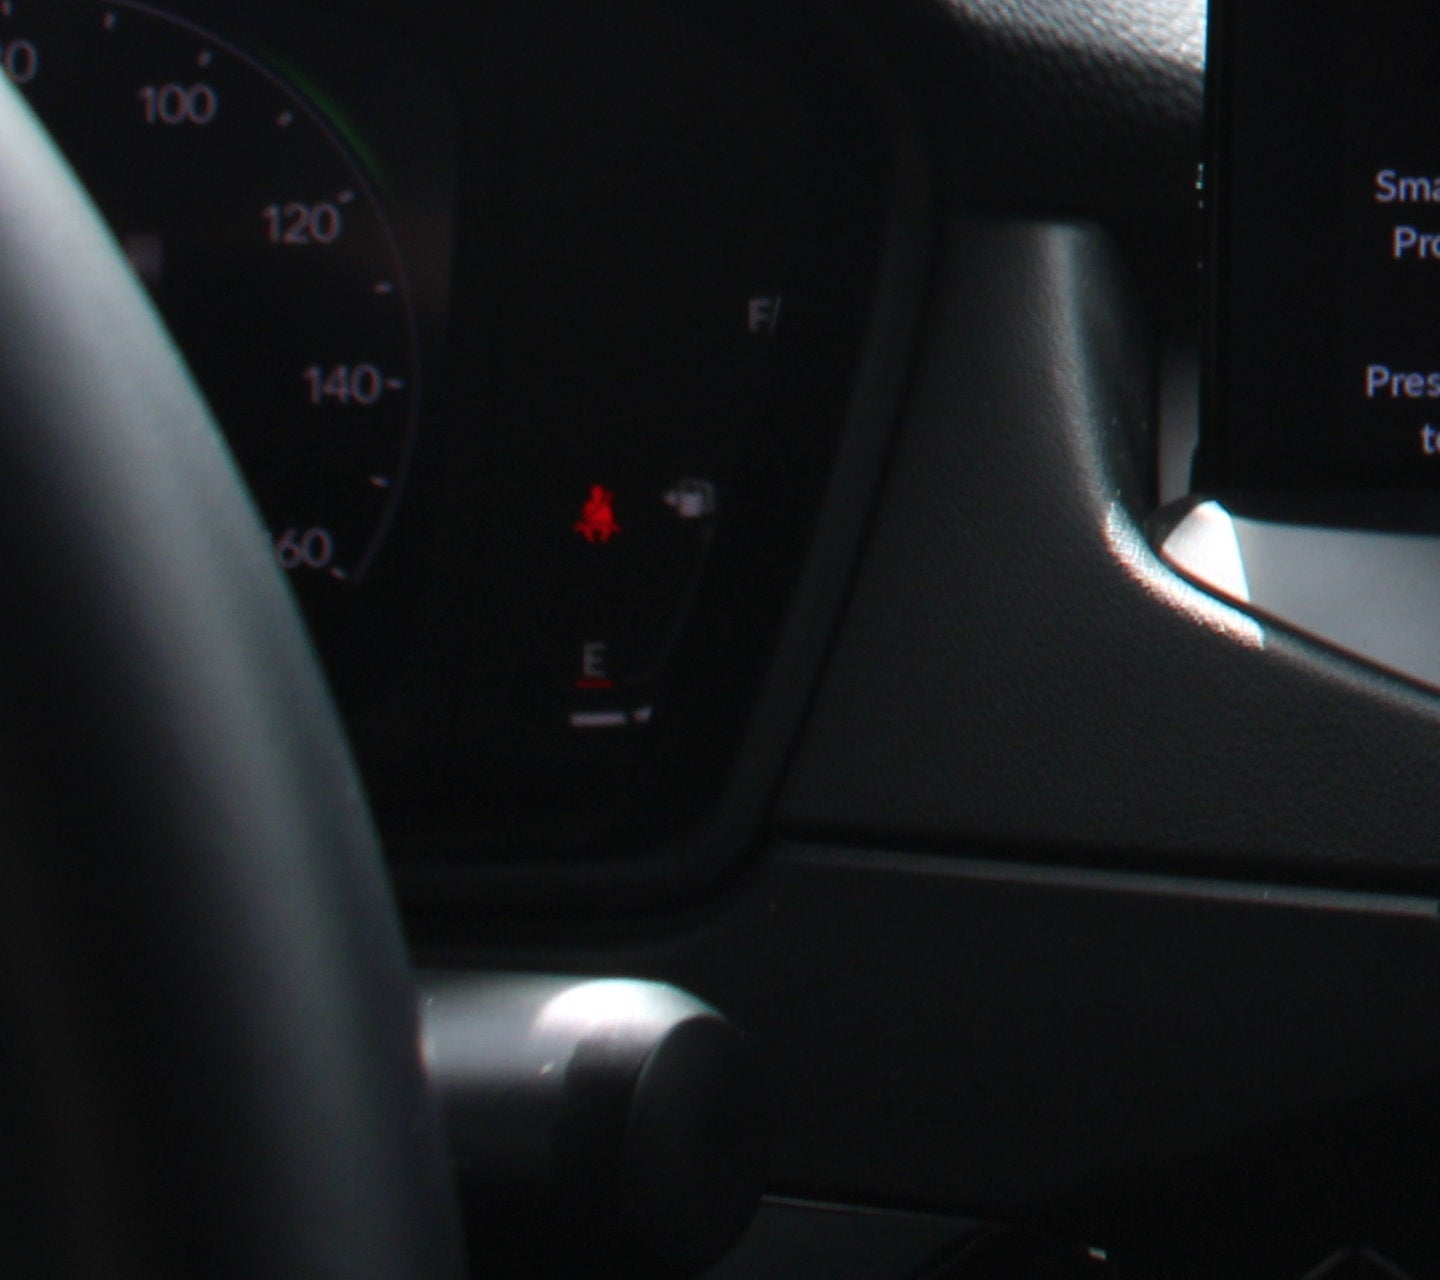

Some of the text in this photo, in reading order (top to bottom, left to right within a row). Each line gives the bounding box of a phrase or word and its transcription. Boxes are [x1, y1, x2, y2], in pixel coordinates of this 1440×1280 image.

[138, 82, 219, 126] 100
[262, 201, 343, 245] 120
[303, 362, 384, 406] 140
[273, 527, 334, 570] 60
